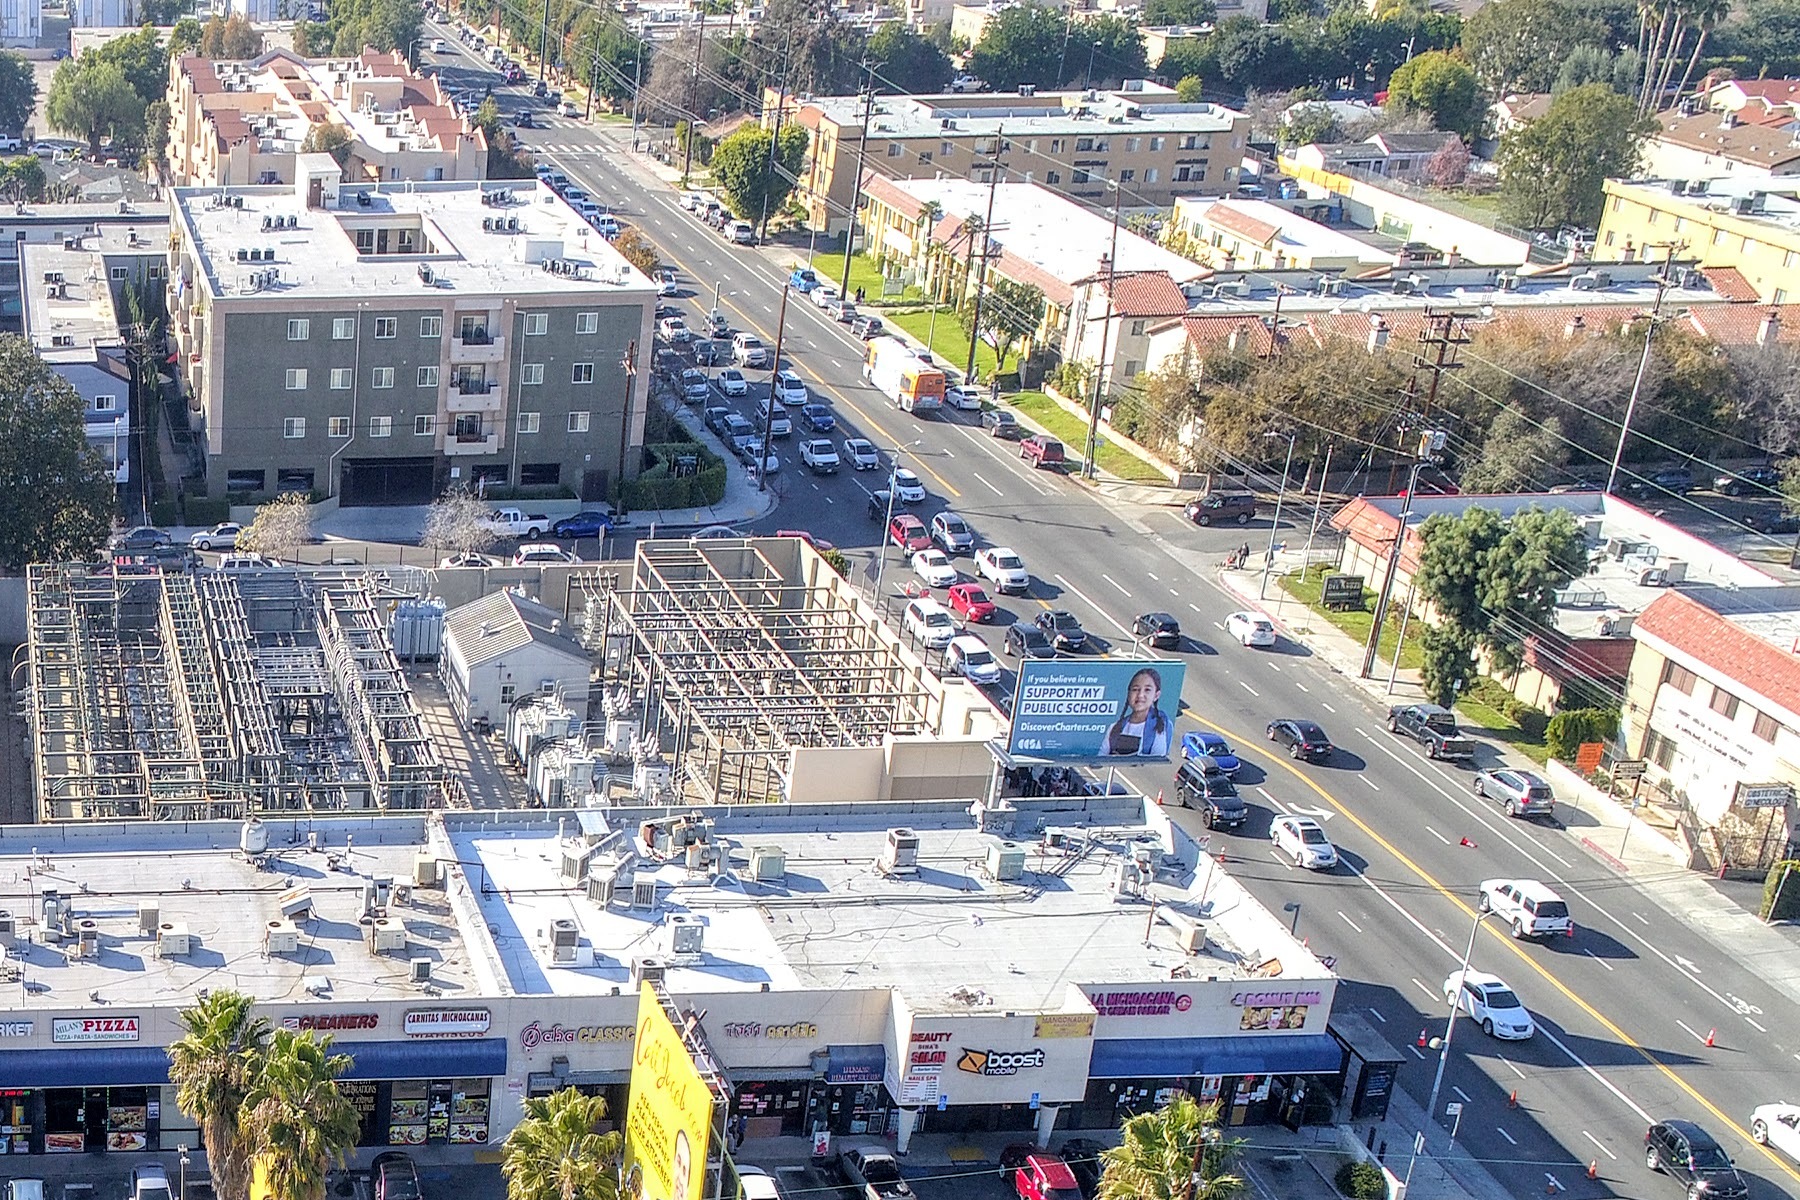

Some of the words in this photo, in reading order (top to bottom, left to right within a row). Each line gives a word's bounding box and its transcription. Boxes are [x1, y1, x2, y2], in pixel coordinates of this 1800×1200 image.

[1027, 674, 1033, 683] If
[1034, 676, 1048, 685] you
[1050, 674, 1075, 683] believe
[1077, 674, 1086, 683] in
[1026, 688, 1079, 698] SUPPORT
[1081, 688, 1101, 698] MY
[1023, 702, 1064, 714] PUBLIC
[1066, 702, 1115, 714] SCHOOL
[1020, 722, 1106, 734] DiscoverCharters.org
[299, 1014, 379, 1030] CLEANERS
[408, 1013, 439, 1023] CARNITAS
[441, 1012, 488, 1022] MICHOACANAS
[82, 1019, 138, 1032] PIZZA
[578, 1026, 636, 1042] CLASSIC
[911, 1032, 952, 1042] BEAUTY
[911, 1051, 947, 1064] SALON
[987, 1050, 1044, 1068] boost
[986, 1067, 1017, 1075] mobile
